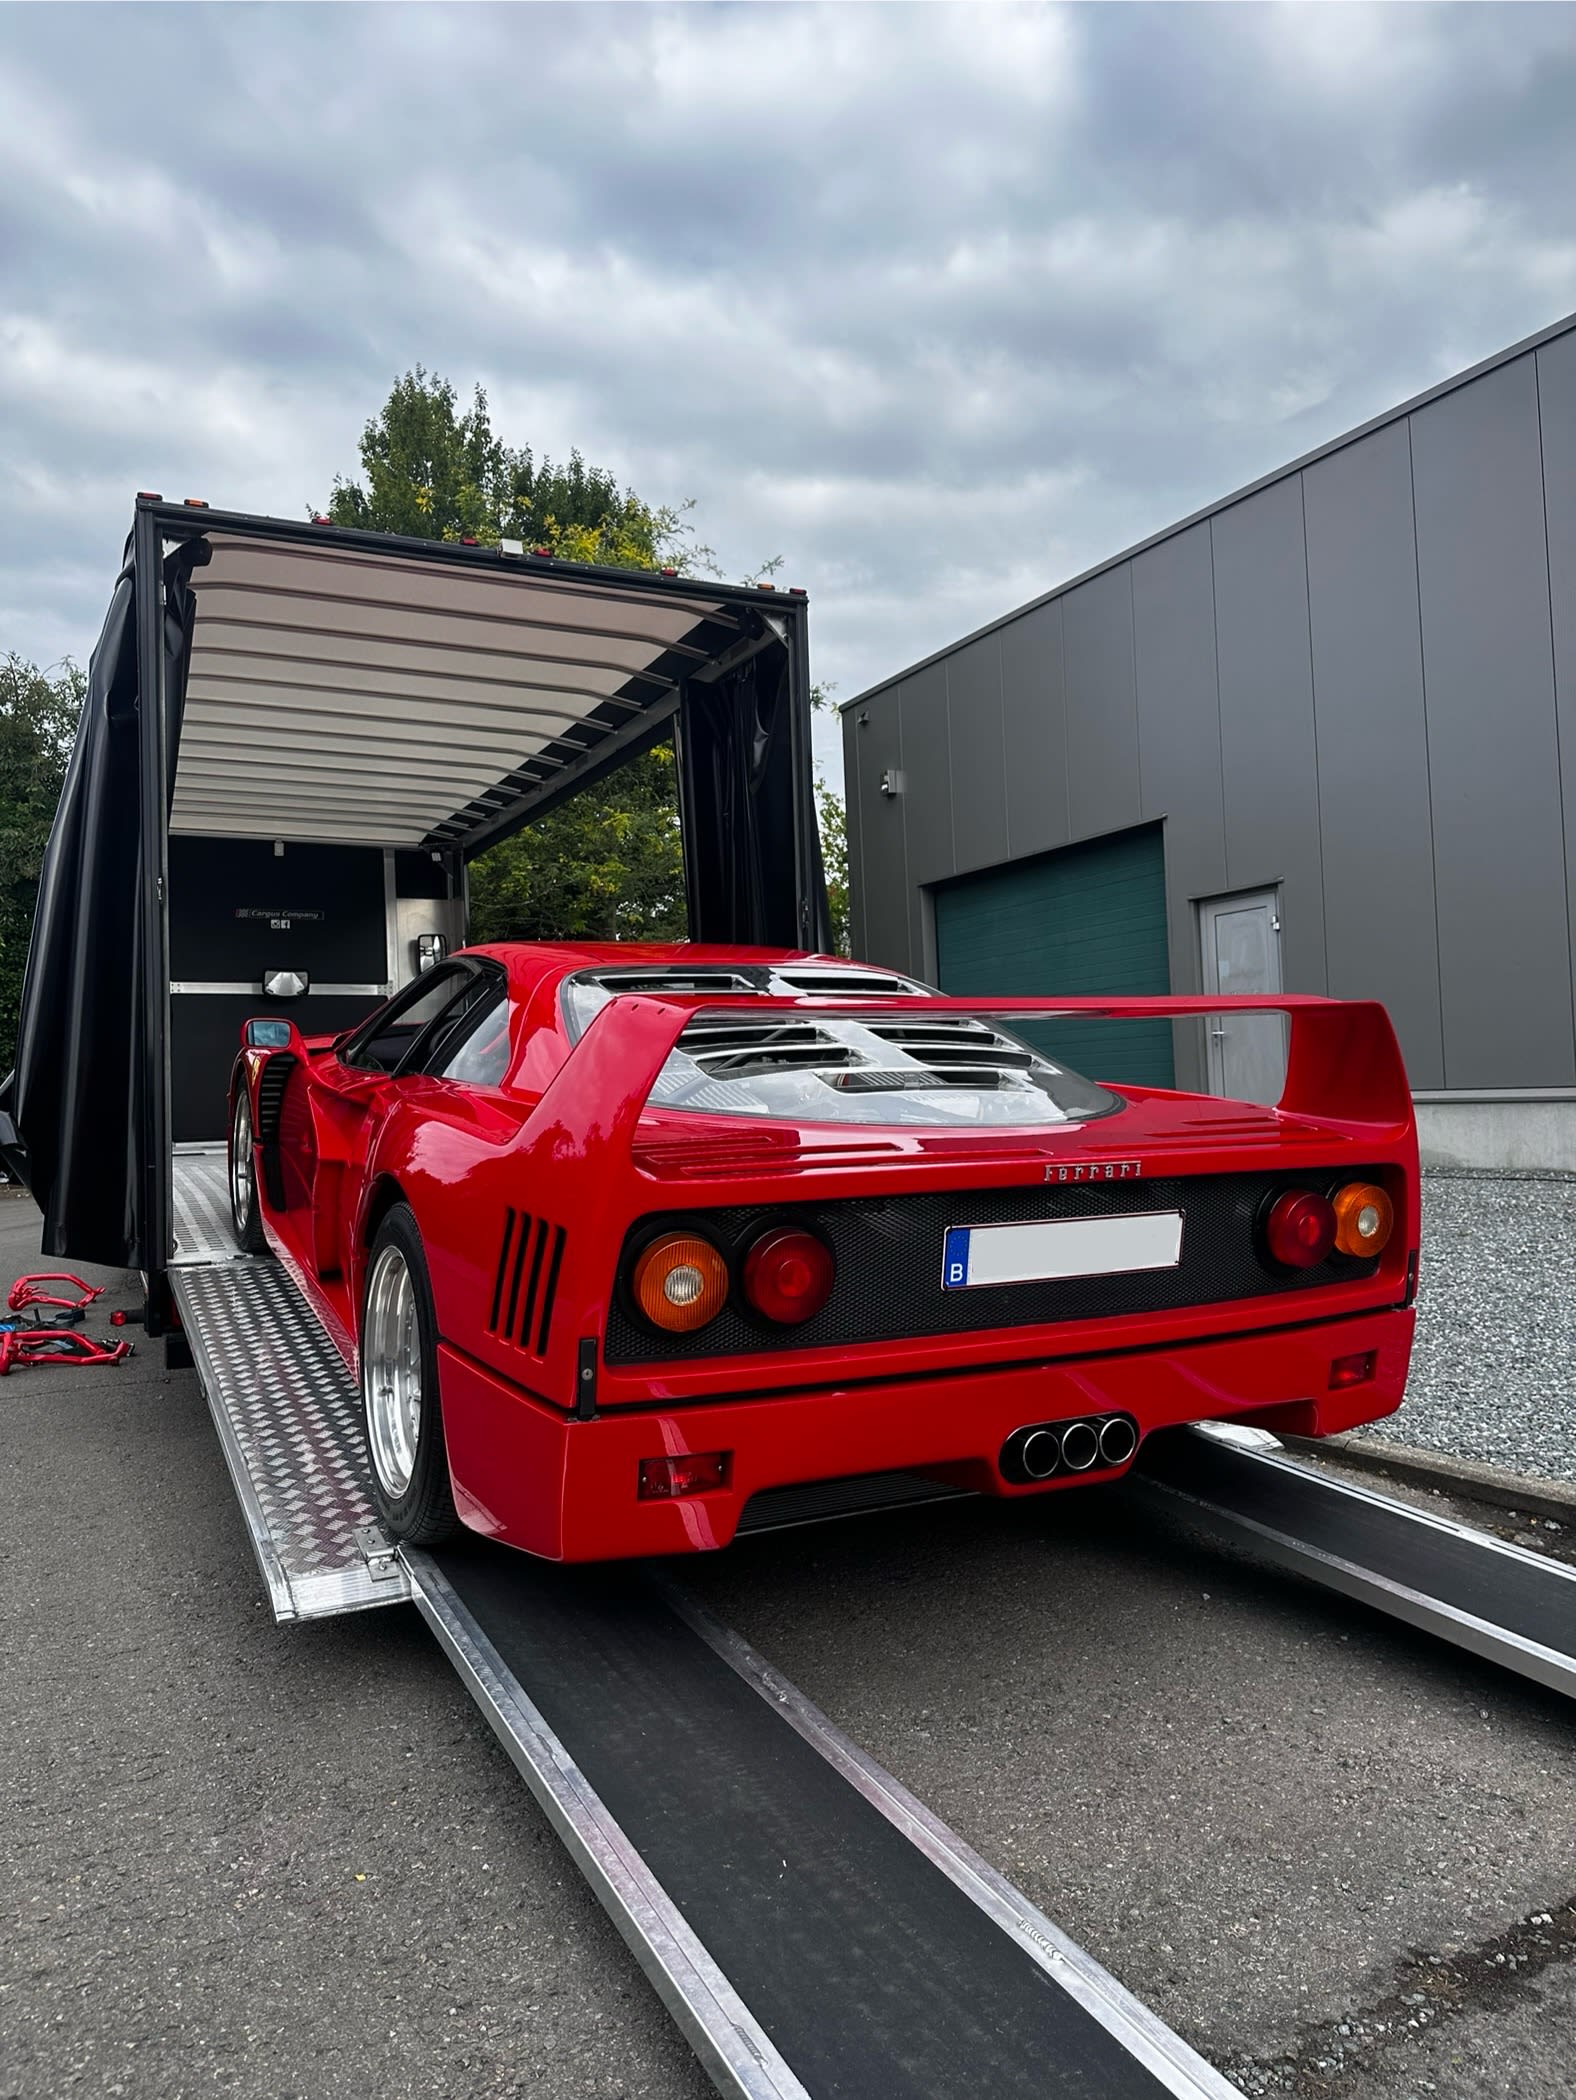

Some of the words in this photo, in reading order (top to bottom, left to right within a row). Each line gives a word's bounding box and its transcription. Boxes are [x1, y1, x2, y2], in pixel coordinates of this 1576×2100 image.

[282, 911, 319, 919] Company
[1044, 1160, 1141, 1181] Ferrari
[949, 1263, 963, 1282] B
